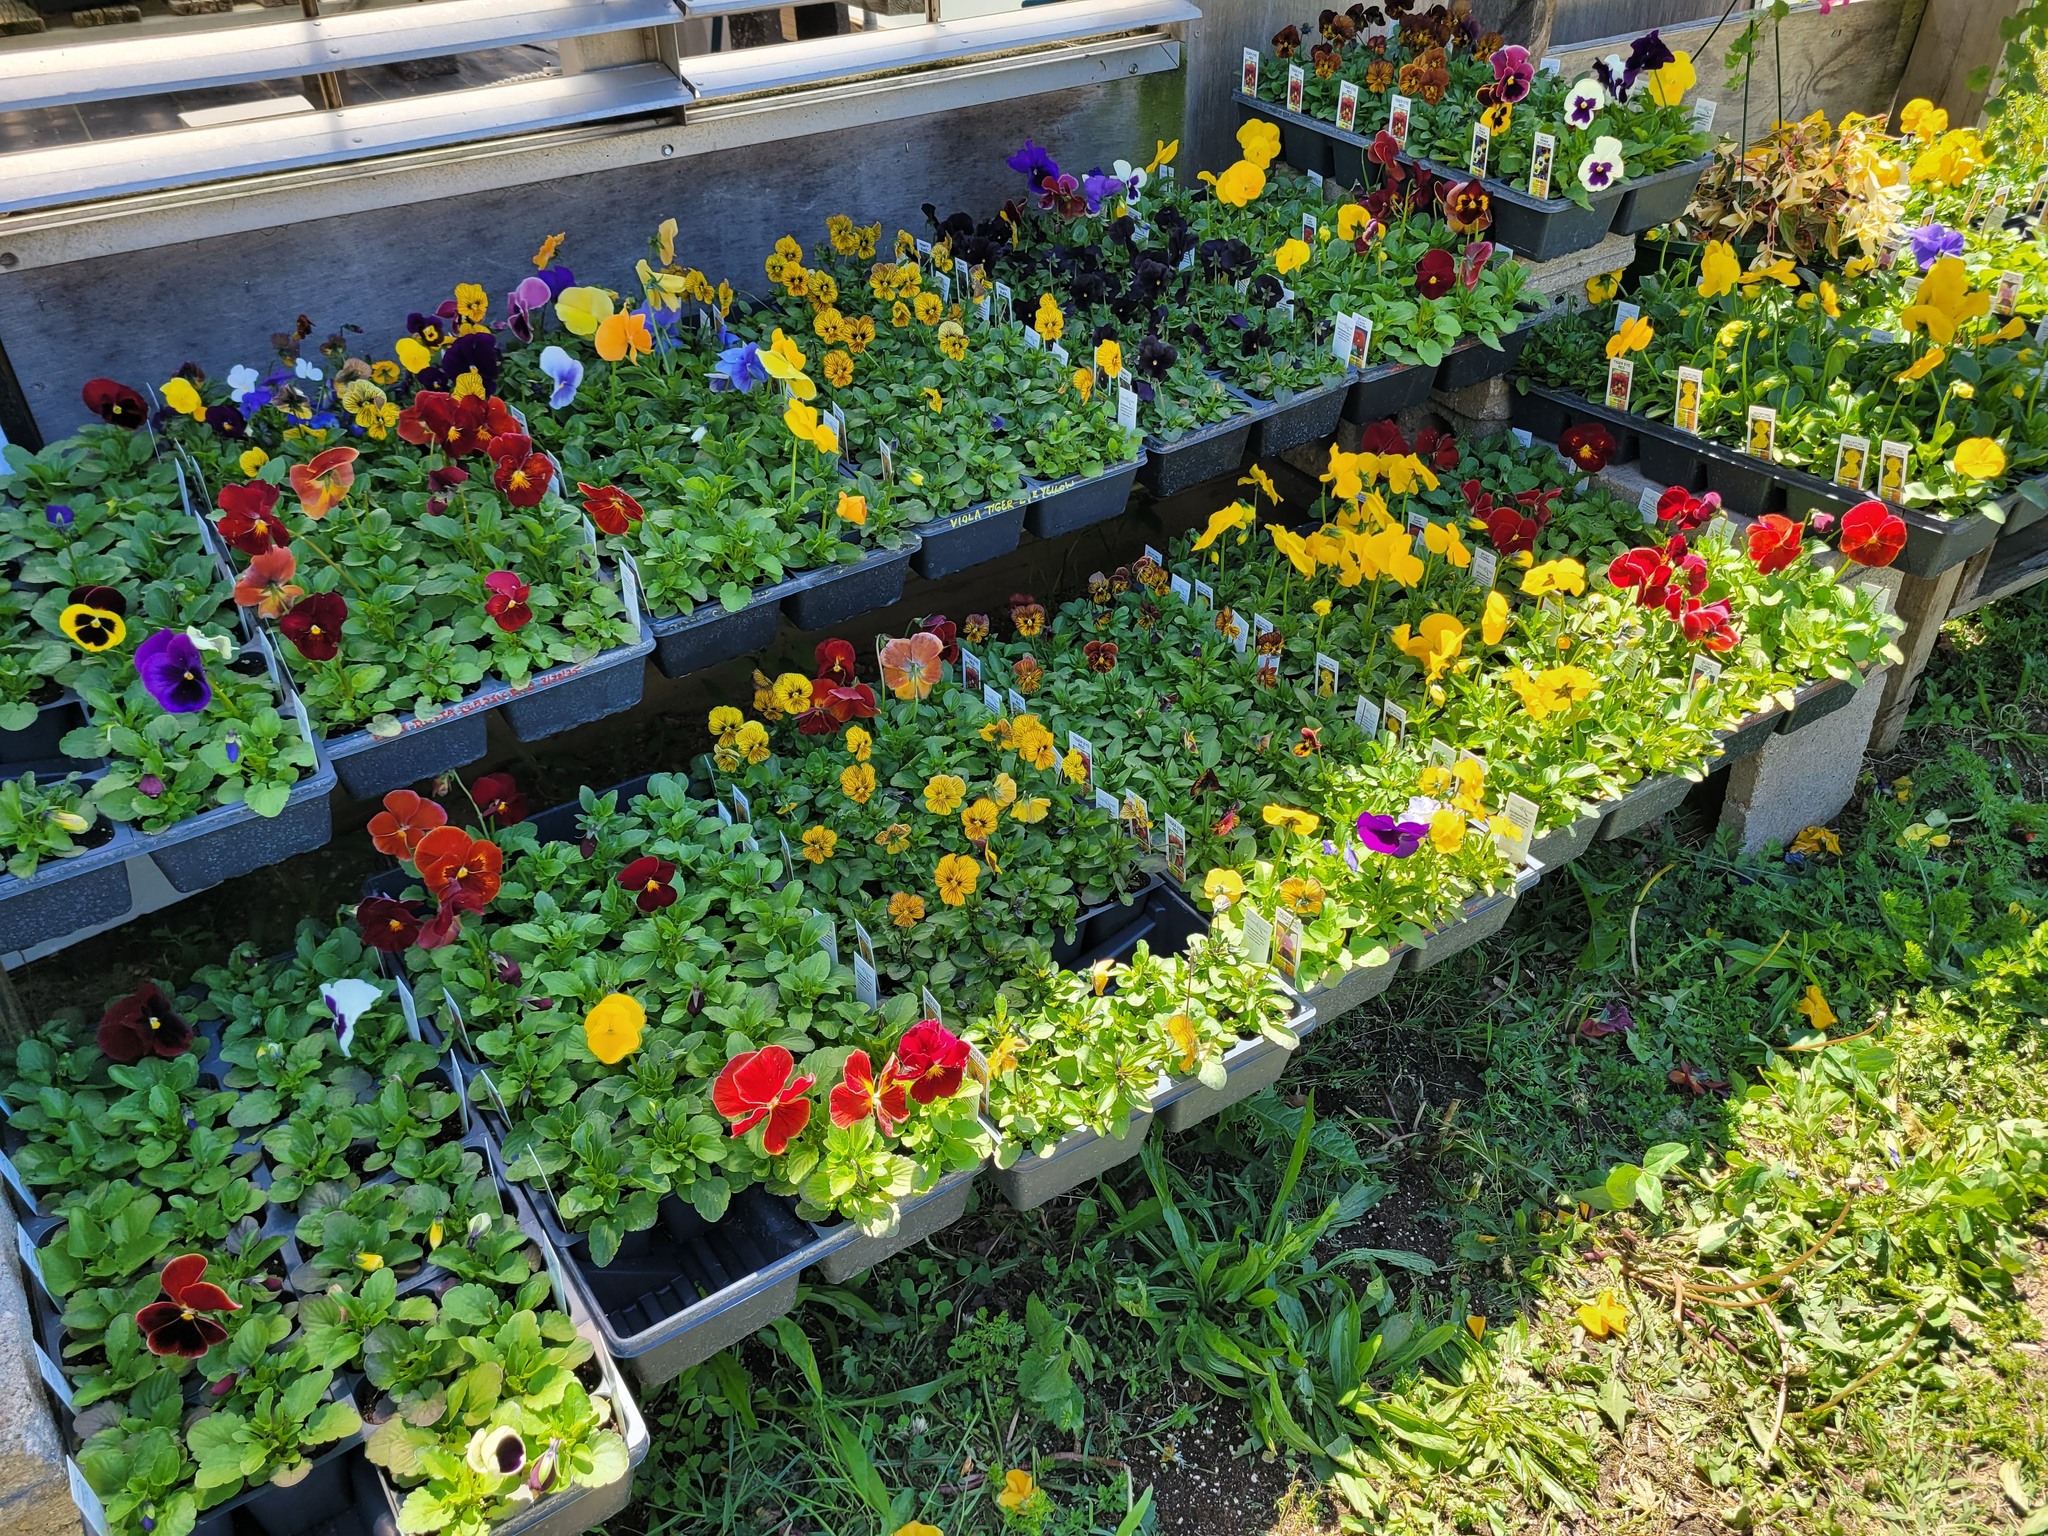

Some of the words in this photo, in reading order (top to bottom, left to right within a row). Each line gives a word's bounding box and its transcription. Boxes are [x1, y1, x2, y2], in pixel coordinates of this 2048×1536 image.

[950, 509, 981, 528] VIOLA
[984, 499, 1014, 515] TIGER
[1040, 480, 1075, 499] YELLOW
